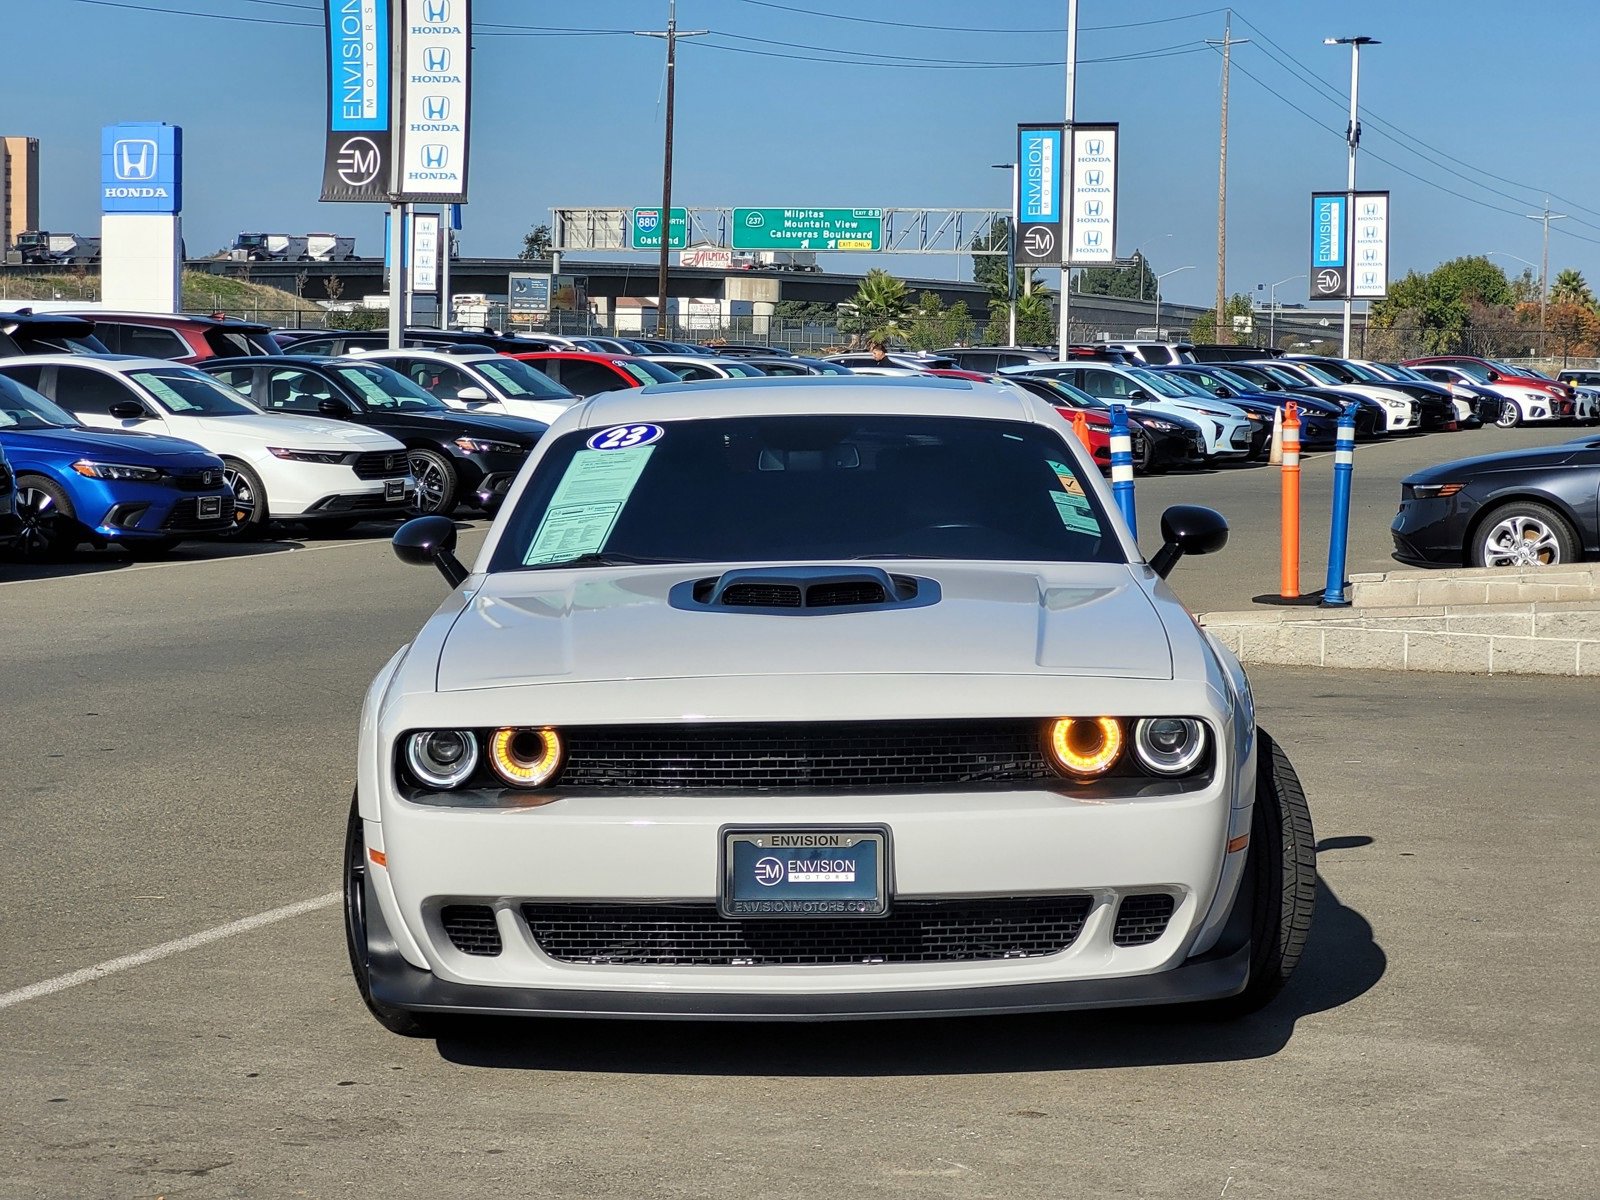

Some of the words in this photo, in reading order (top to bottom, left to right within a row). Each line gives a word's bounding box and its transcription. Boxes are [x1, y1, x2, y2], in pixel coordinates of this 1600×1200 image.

[365, 7, 374, 108] MOTORS
[410, 124, 460, 132] HONDA
[409, 172, 458, 180] HONDA
[1028, 138, 1042, 215] ENVISION
[105, 187, 168, 198] HONDA
[784, 210, 824, 219] Milpitas
[639, 217, 656, 227] 880
[784, 220, 830, 228] Mountain
[835, 220, 858, 228] View
[770, 230, 818, 238] Calaveras
[823, 230, 872, 239] Boulevard
[1320, 203, 1331, 261] ENVISION
[640, 236, 679, 245] Oaklnd
[599, 426, 648, 449] 23
[771, 835, 839, 846] ENVISION
[788, 860, 855, 872] ENVISION
[735, 901, 878, 912] ENVISIONMOTORS.COM
